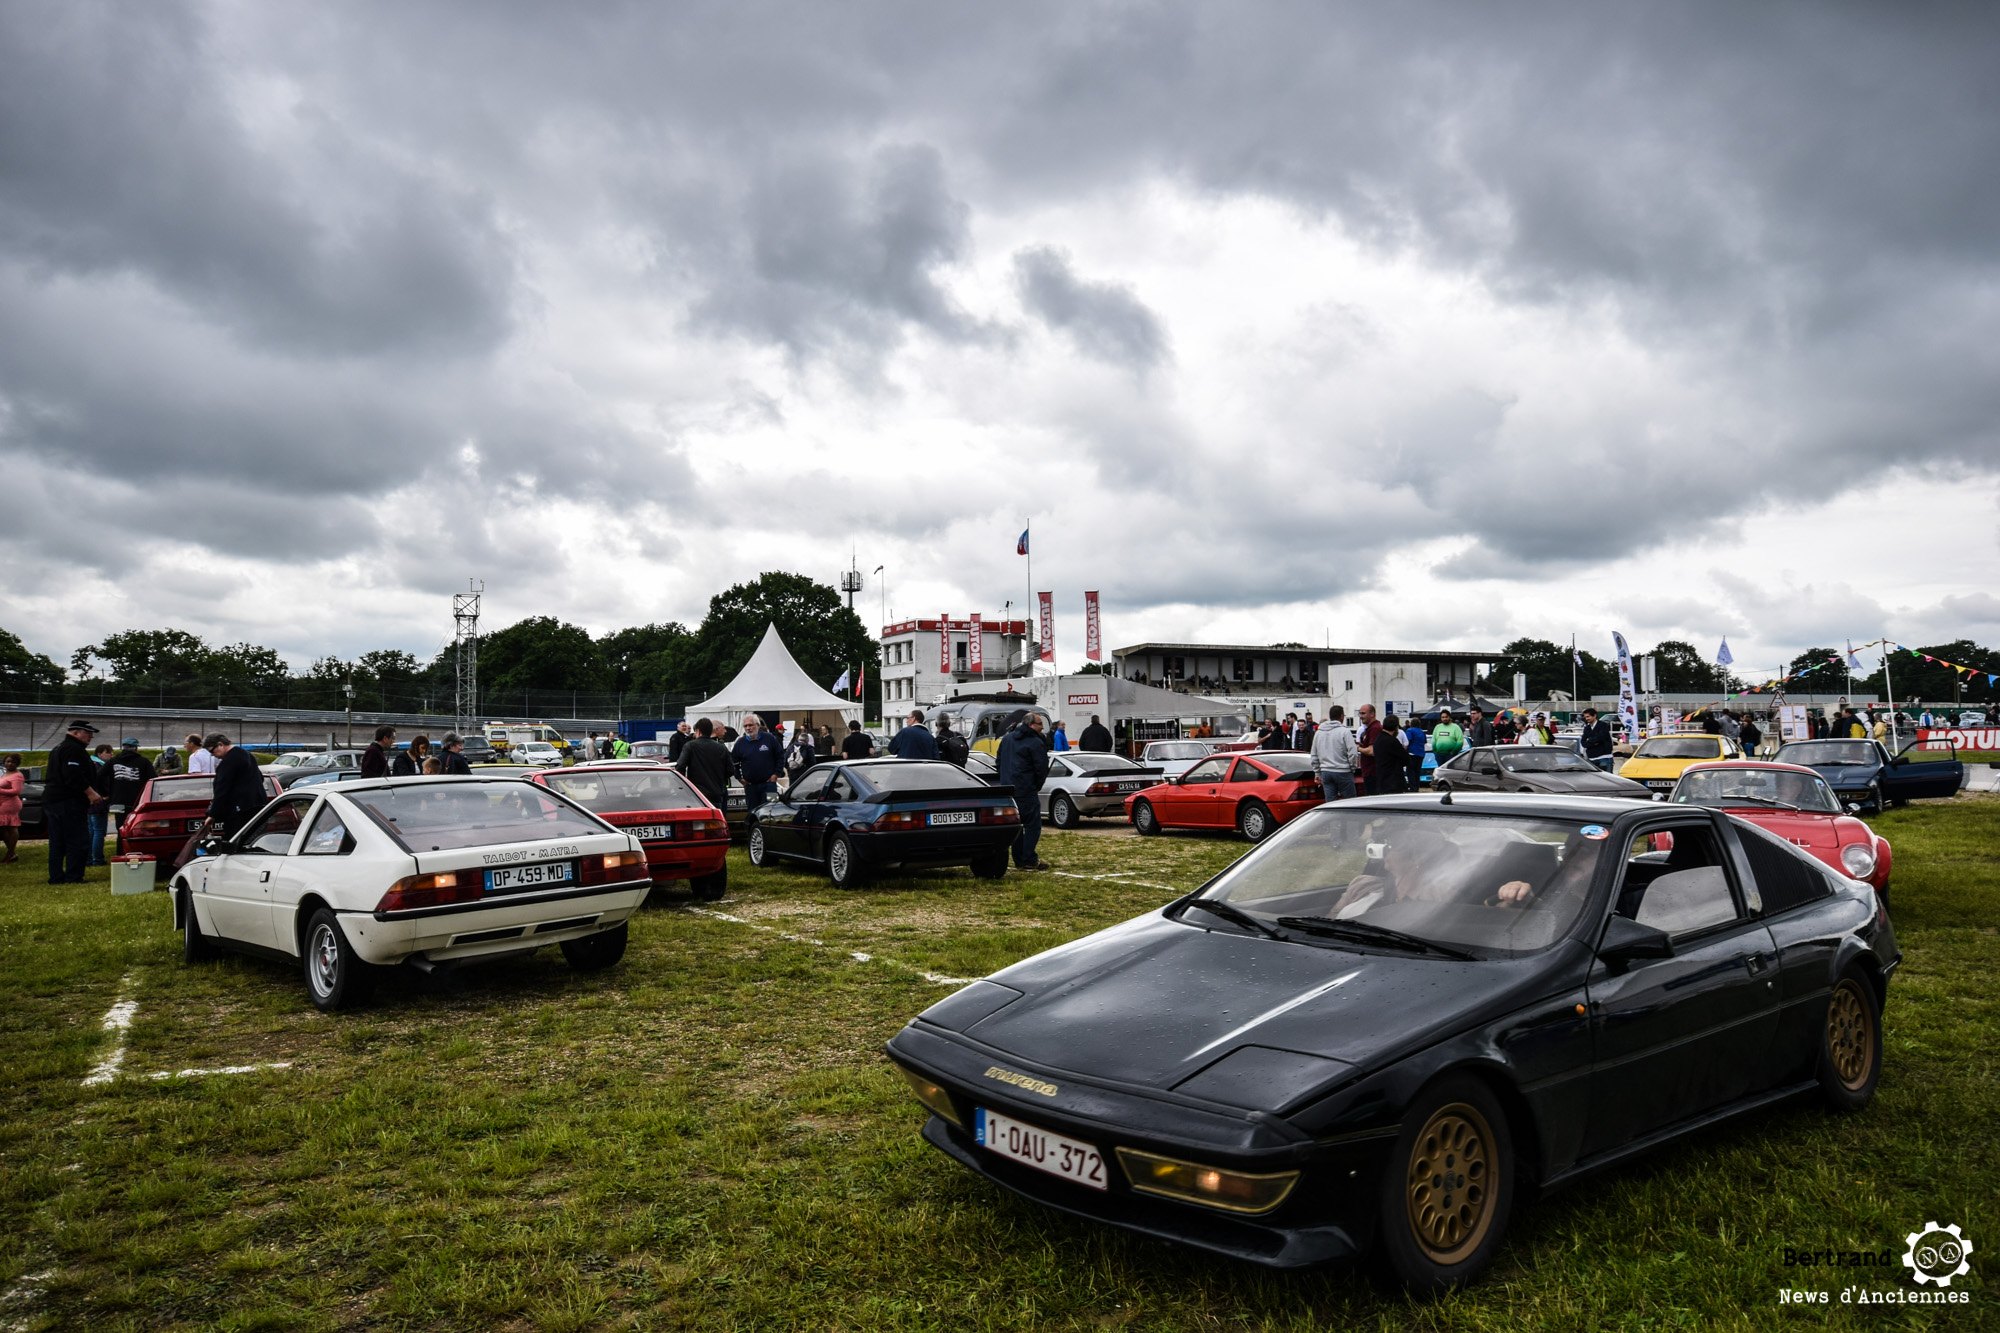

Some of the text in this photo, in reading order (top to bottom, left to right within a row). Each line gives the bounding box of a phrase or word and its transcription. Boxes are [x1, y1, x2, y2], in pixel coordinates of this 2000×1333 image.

[1070, 695, 1098, 704] MOTUL
[932, 812, 973, 824] 8001 SP 58
[483, 851, 527, 864] TALBOT
[539, 846, 579, 858] MATRA
[493, 864, 564, 887] DP-459-MD
[984, 1066, 1059, 1097] murena
